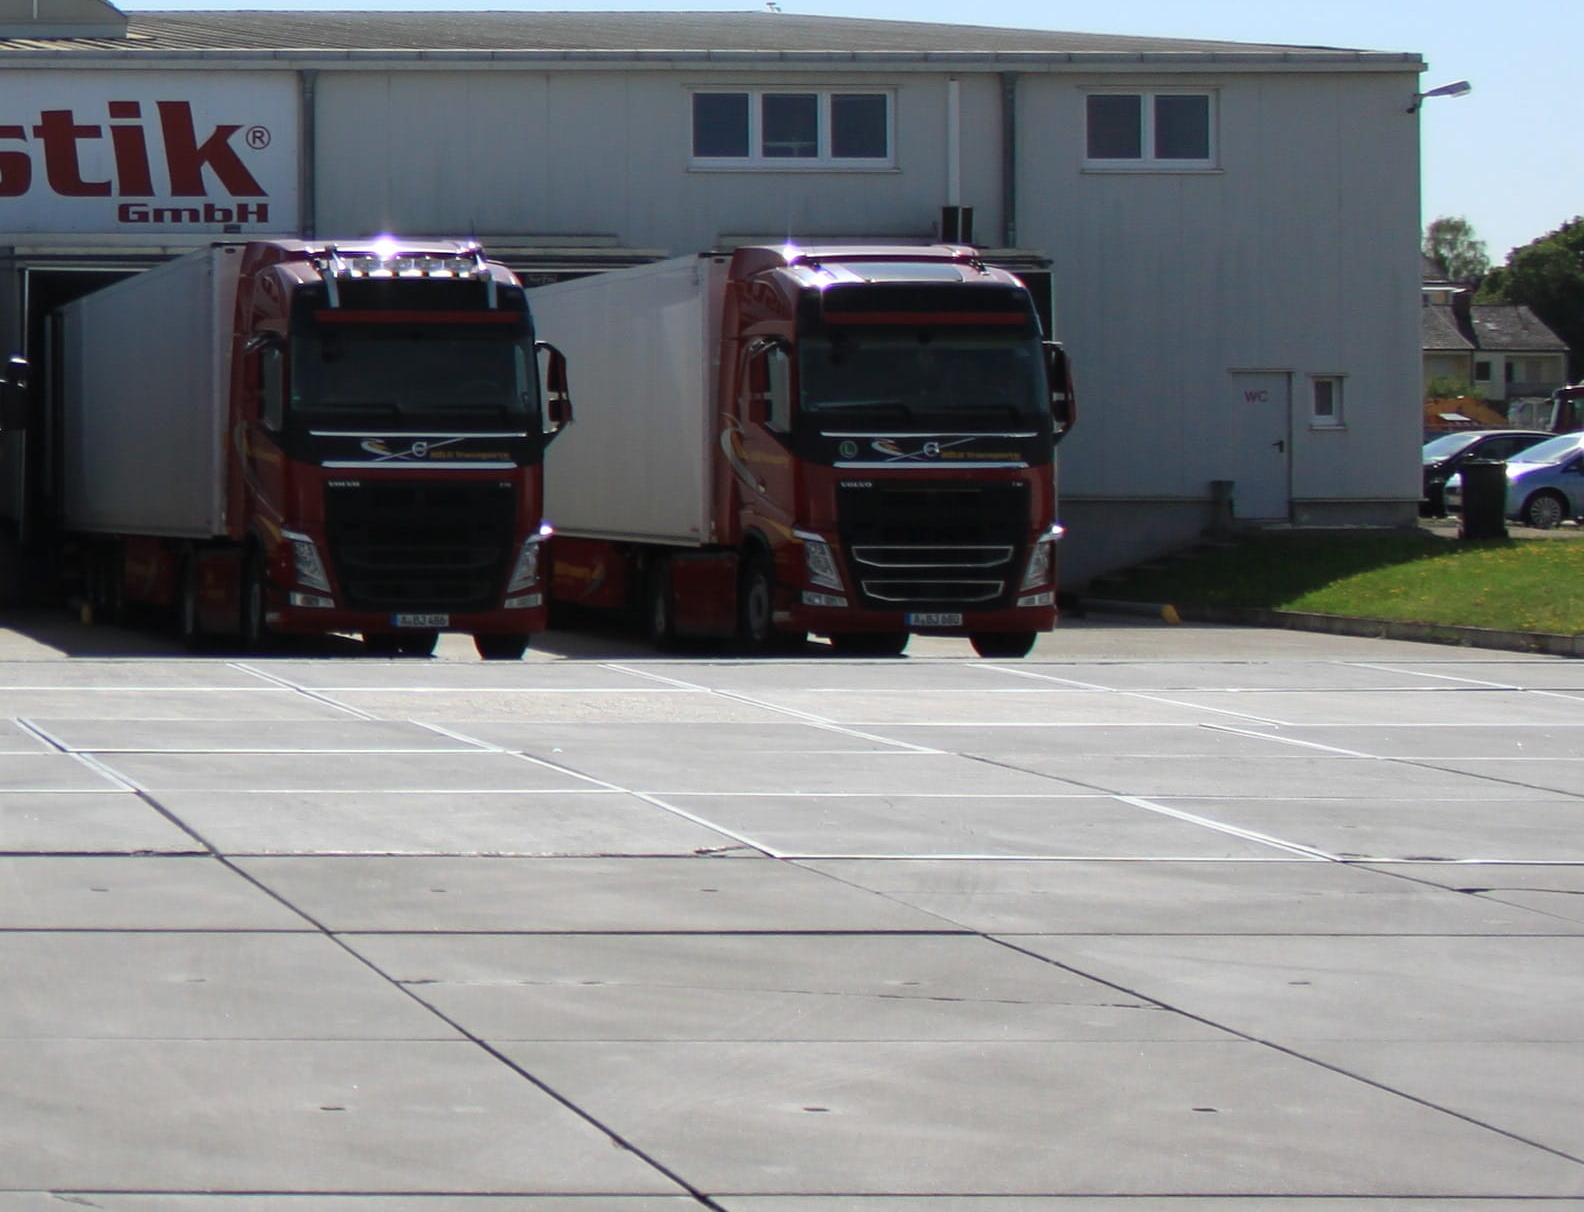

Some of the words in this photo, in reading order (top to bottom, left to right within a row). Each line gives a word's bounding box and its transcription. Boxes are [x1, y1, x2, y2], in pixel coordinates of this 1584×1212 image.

[117, 202, 269, 224] GmbH
[1244, 390, 1268, 403] WC
[840, 481, 873, 489] VOLVO
